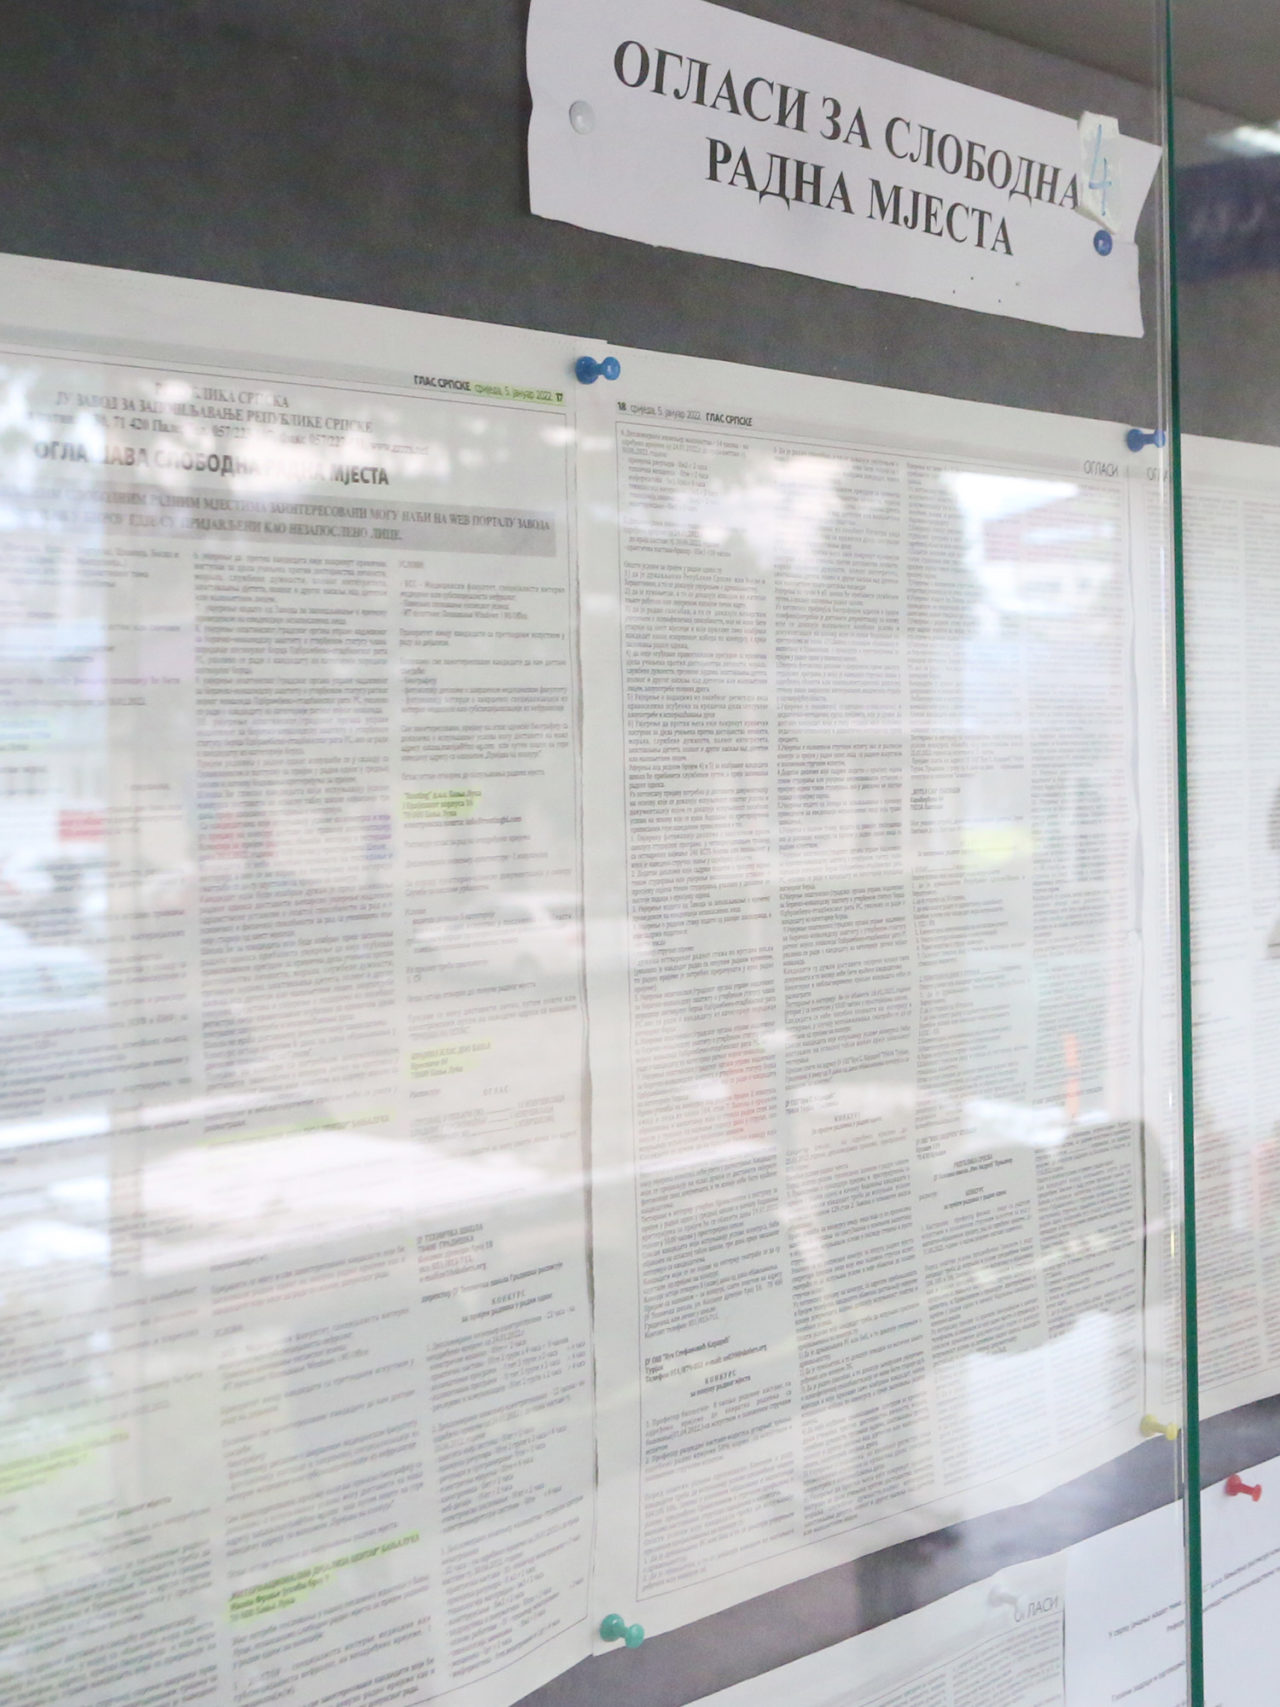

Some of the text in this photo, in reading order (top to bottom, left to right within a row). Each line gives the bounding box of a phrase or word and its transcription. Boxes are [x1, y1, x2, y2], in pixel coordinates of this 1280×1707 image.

[612, 39, 1080, 211] ОГЛАСИ ЗА СЛОБОДНА
[704, 137, 1015, 257] РАДНА МЈЕСТА
[413, 374, 436, 388] ГЛАС
[437, 378, 471, 391] СРПСКЕ
[139, 399, 244, 422] ЗАПШЉАВАЊЕ
[706, 412, 725, 424] ГЛАС
[726, 414, 753, 427] СРПСКЕ
[34, 440, 149, 468] ОГЛААВА
[331, 463, 390, 486] МЈЕСТА
[1083, 459, 1118, 478] ОГЛАСИ
